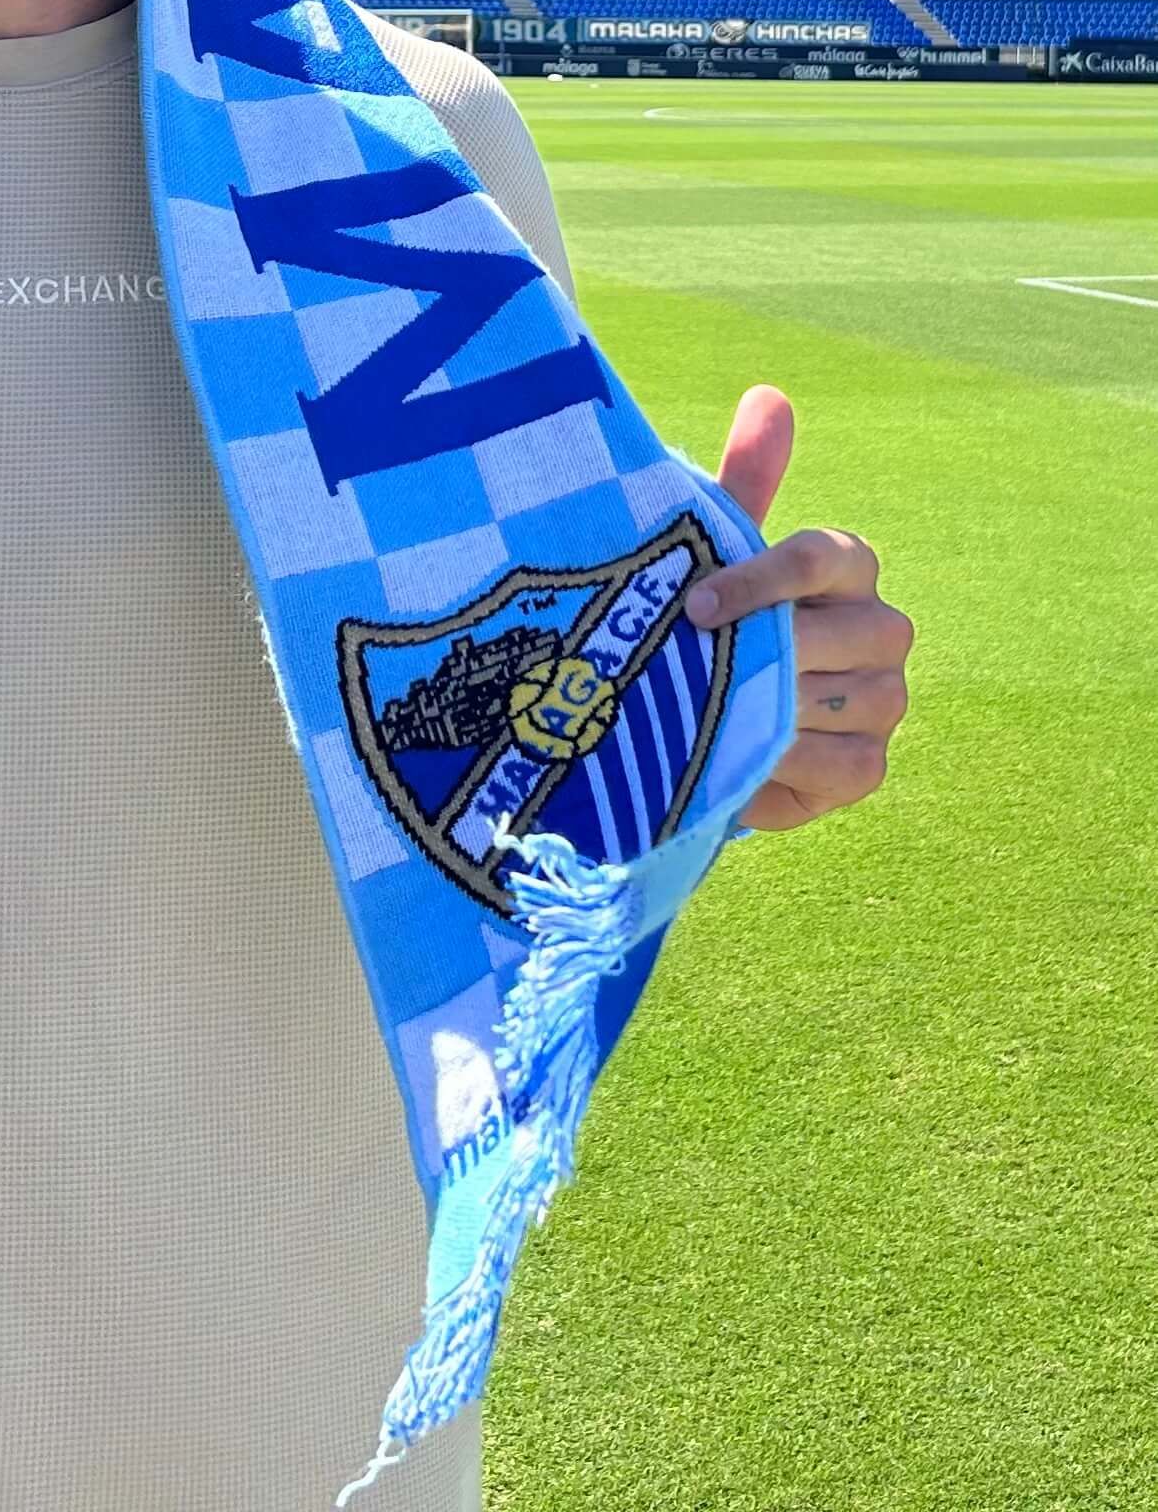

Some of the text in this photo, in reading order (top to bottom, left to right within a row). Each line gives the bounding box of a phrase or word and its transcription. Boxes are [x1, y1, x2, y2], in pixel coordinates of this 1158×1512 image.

[494, 18, 567, 43] 1904
[757, 22, 868, 41] HINCHAS
[691, 47, 779, 61] SERES
[920, 48, 987, 65] hummel
[442, 1091, 531, 1189] mála
